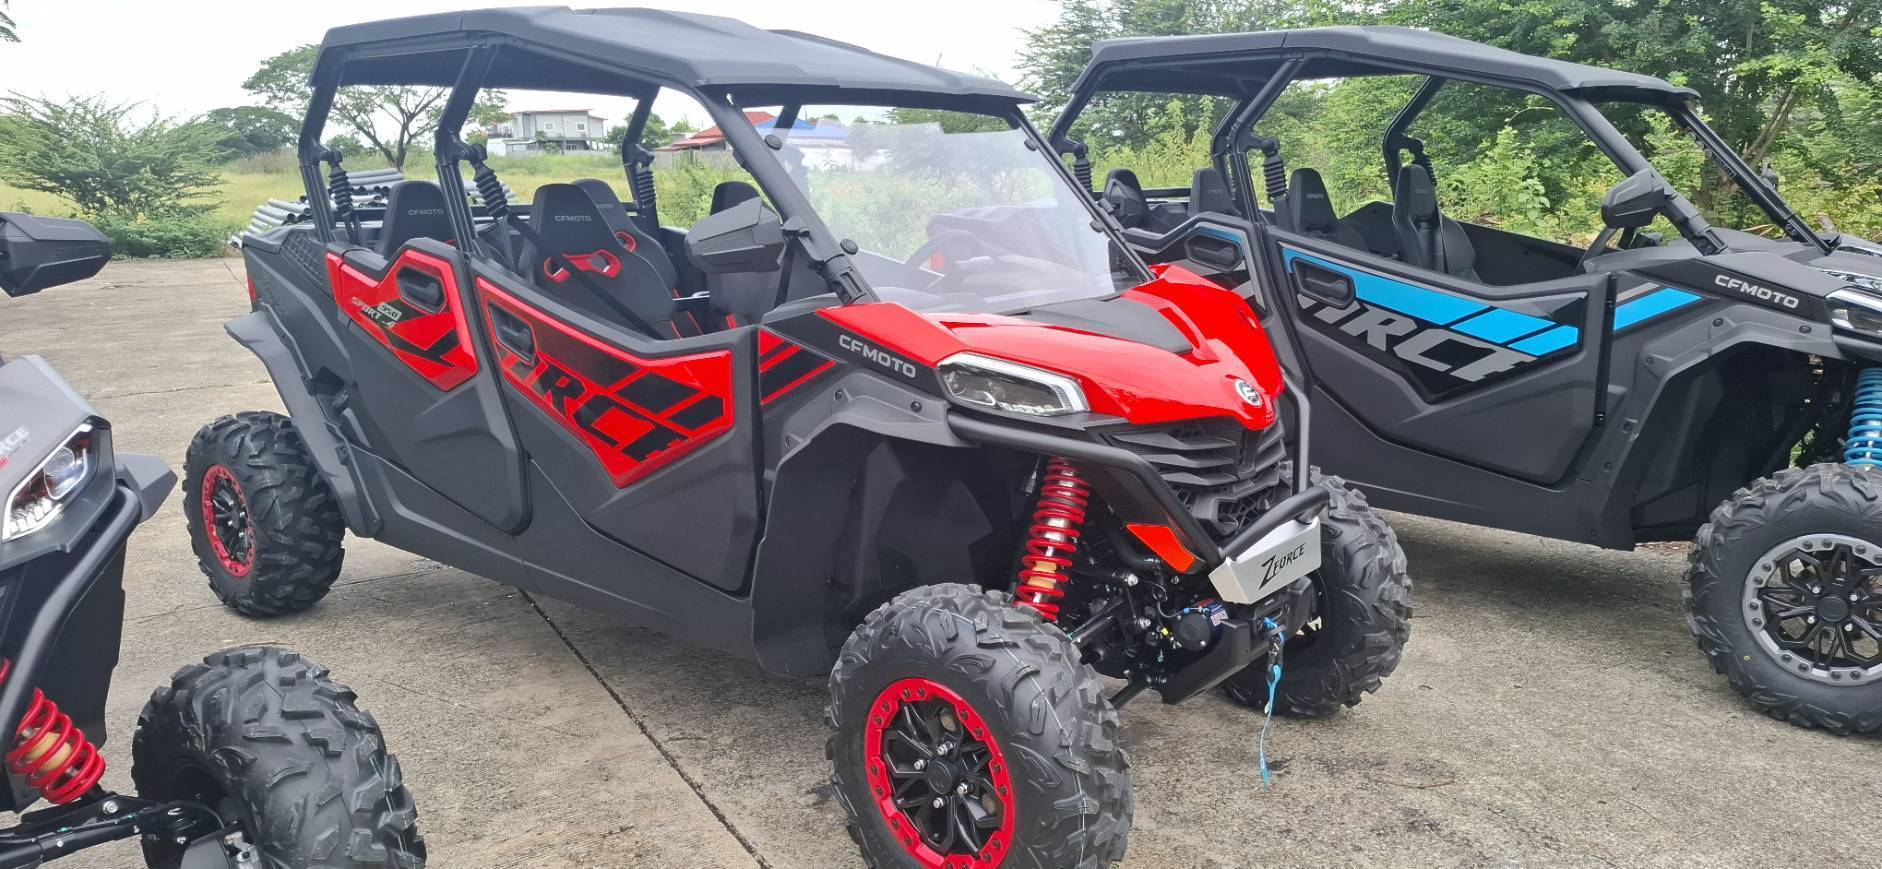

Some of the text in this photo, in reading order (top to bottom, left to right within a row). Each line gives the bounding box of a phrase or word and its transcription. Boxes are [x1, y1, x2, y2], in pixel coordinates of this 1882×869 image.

[1715, 274, 1799, 309] CFMOTO
[839, 334, 916, 378] CFMOTO
[1258, 543, 1306, 590] ZFORCE
